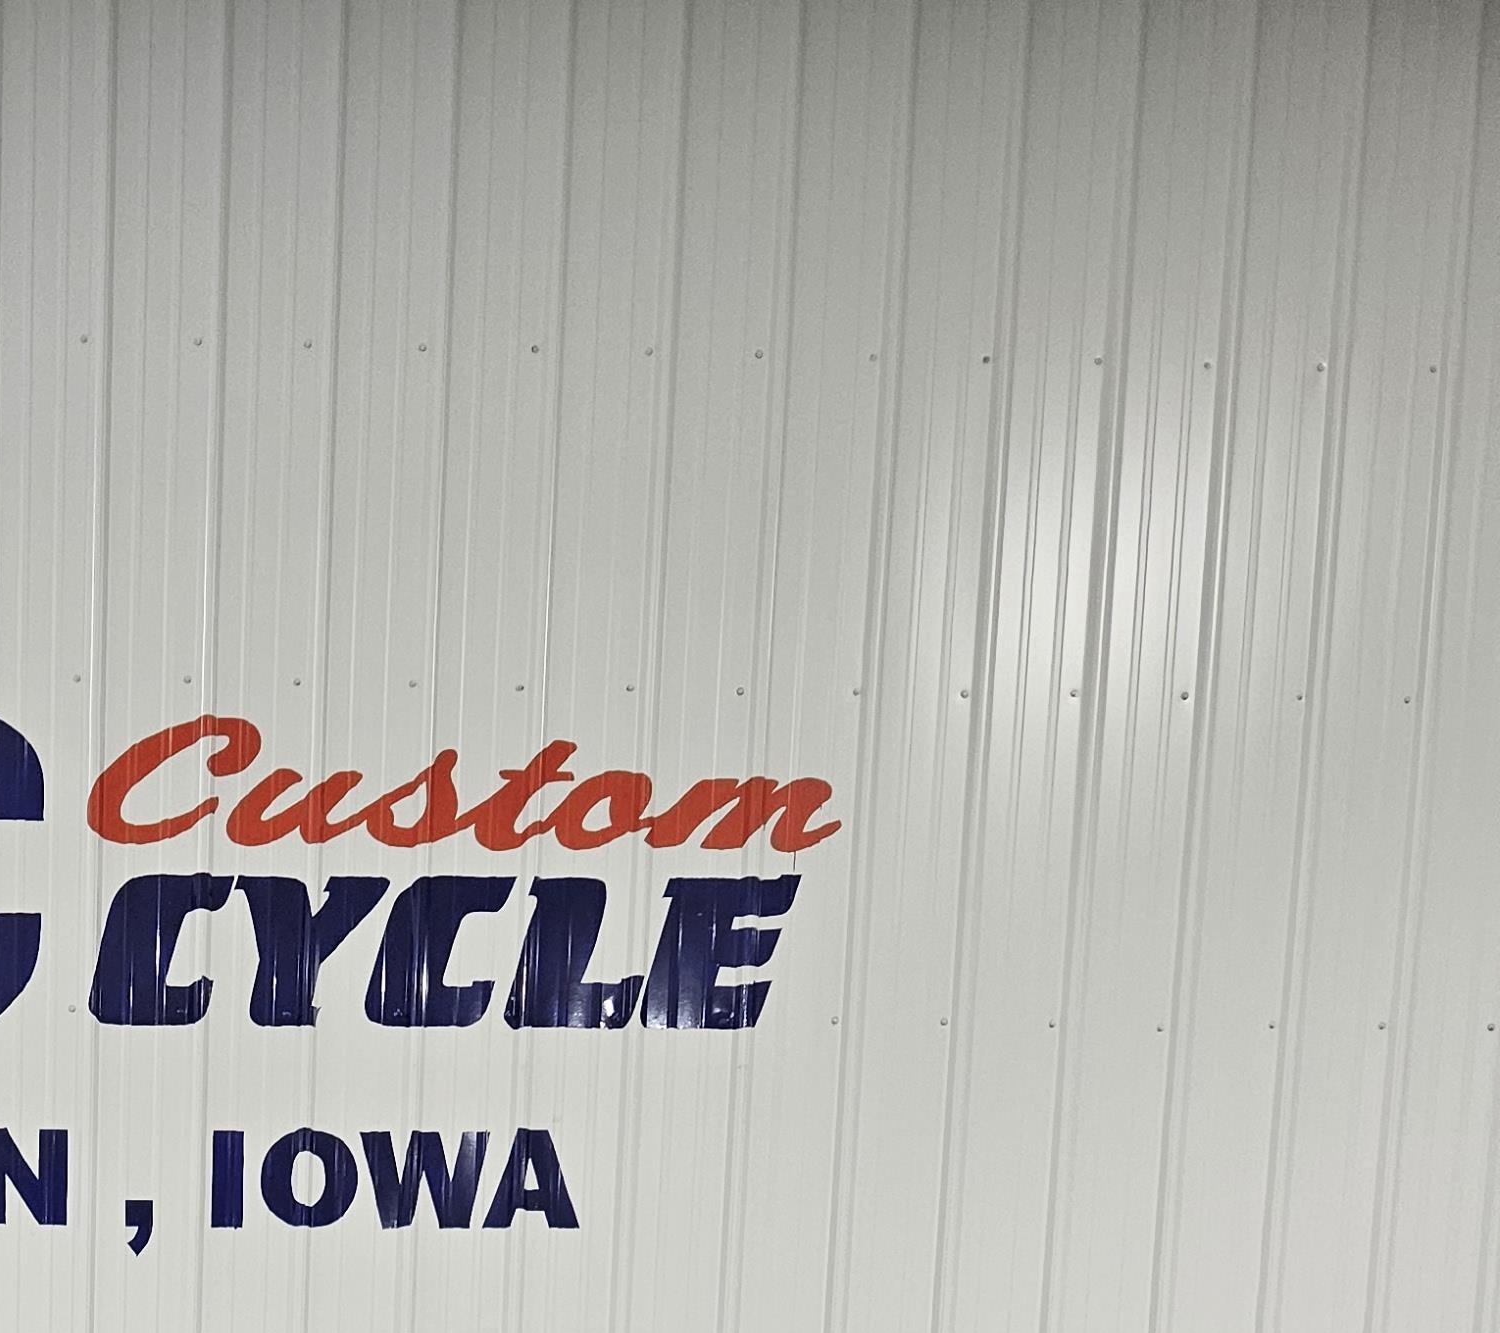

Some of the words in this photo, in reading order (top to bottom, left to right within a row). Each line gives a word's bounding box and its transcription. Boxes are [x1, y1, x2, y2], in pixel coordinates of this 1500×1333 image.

[87, 714, 842, 852] Custom
[87, 872, 802, 1030] CYCLE
[212, 1127, 580, 1230] IOWA
